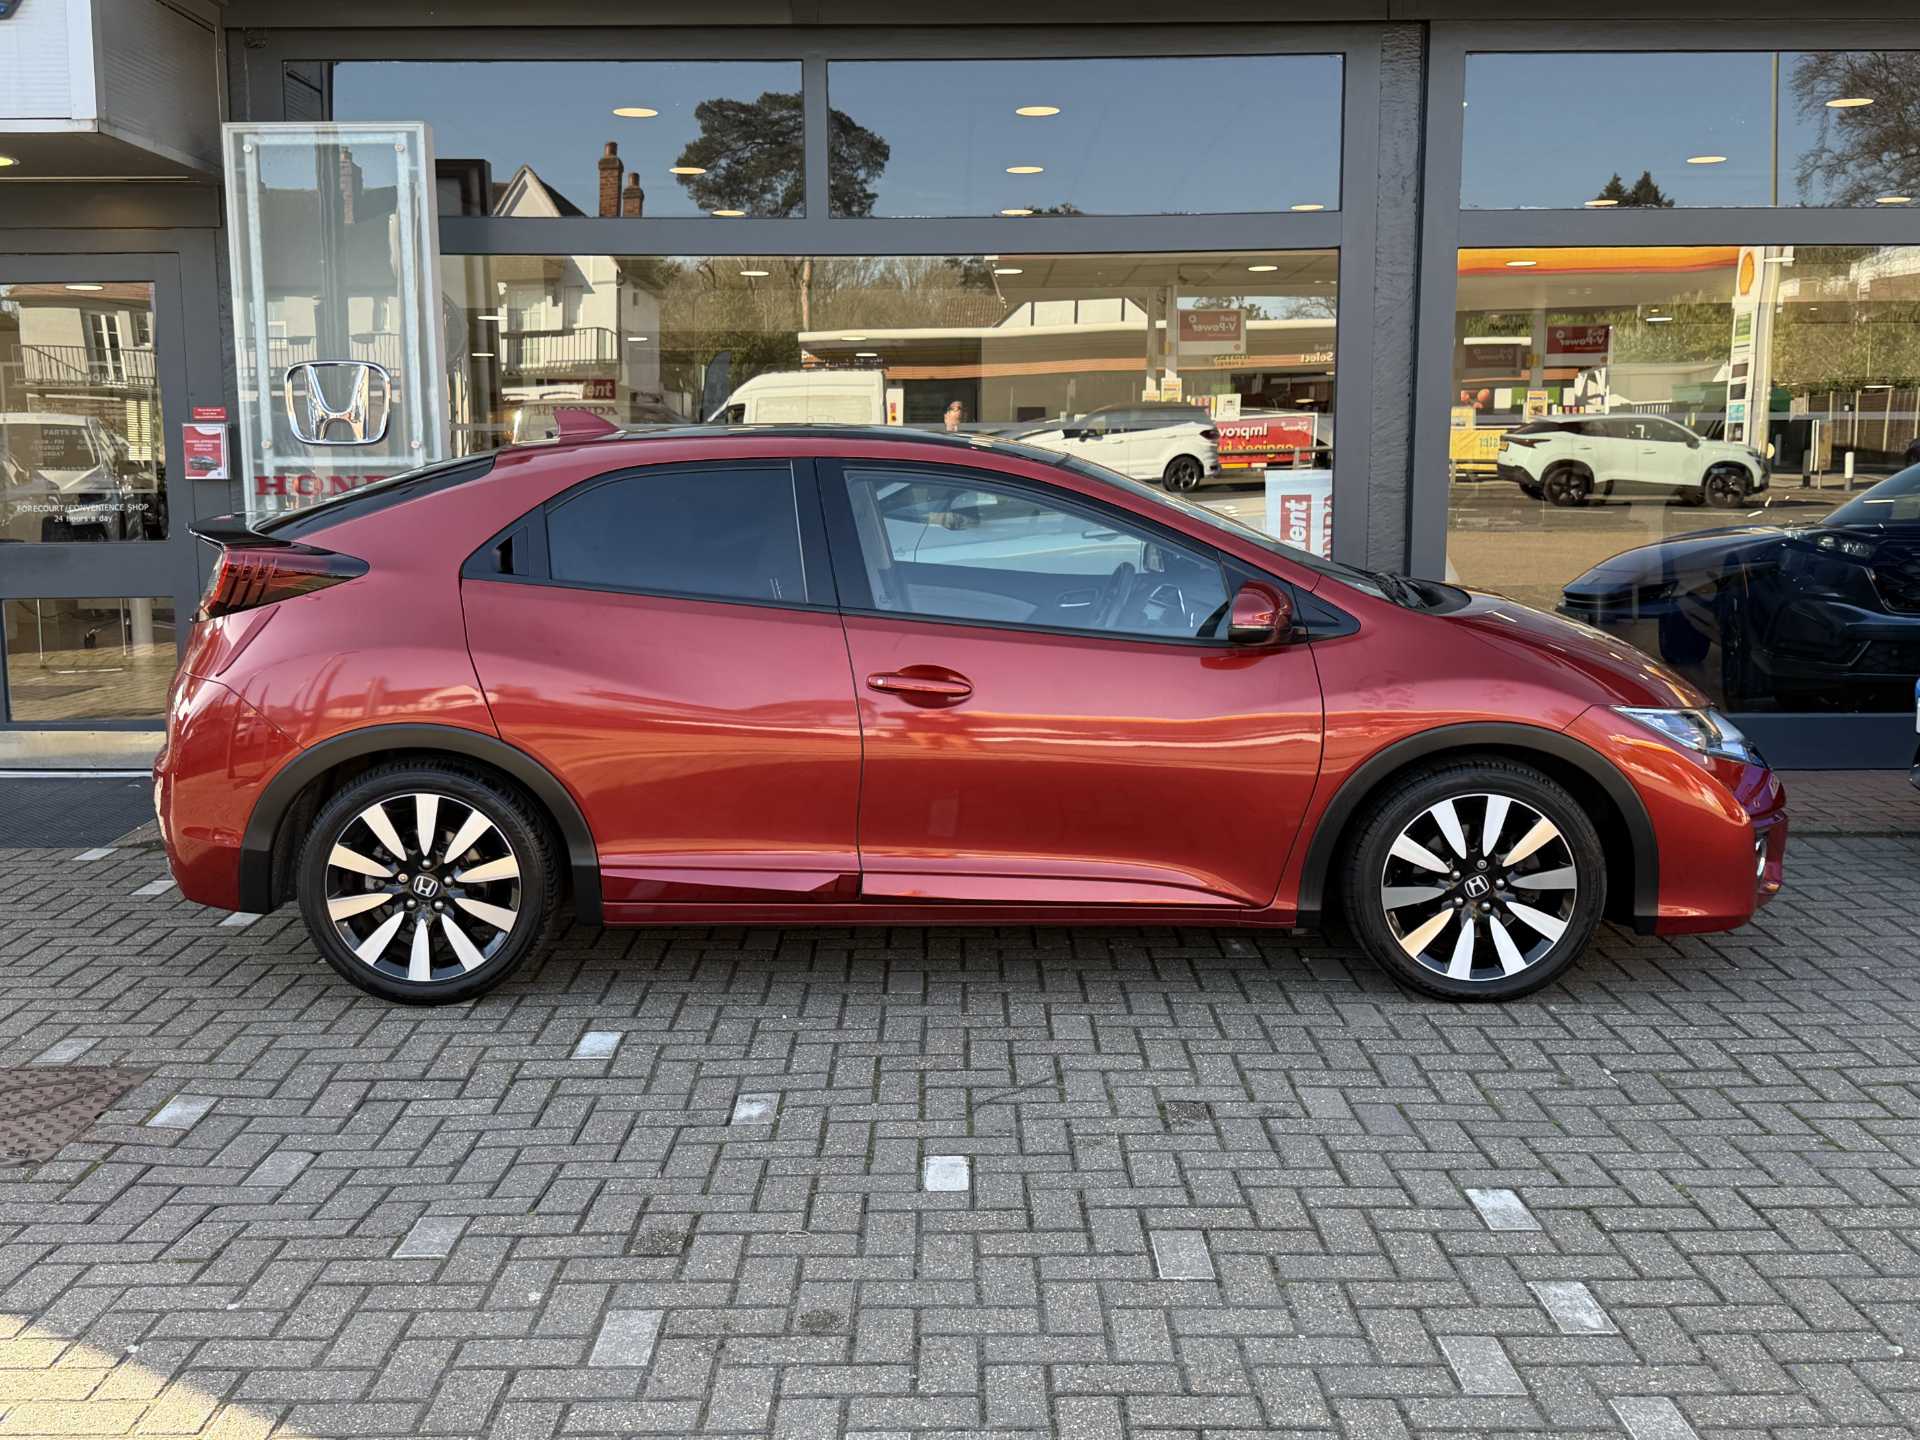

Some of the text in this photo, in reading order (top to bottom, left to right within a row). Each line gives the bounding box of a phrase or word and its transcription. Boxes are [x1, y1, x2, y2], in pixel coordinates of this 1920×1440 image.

[255, 474, 389, 497] HON
[127, 503, 149, 513] SHOP
[54, 515, 64, 523] 24
[99, 514, 113, 524] day
